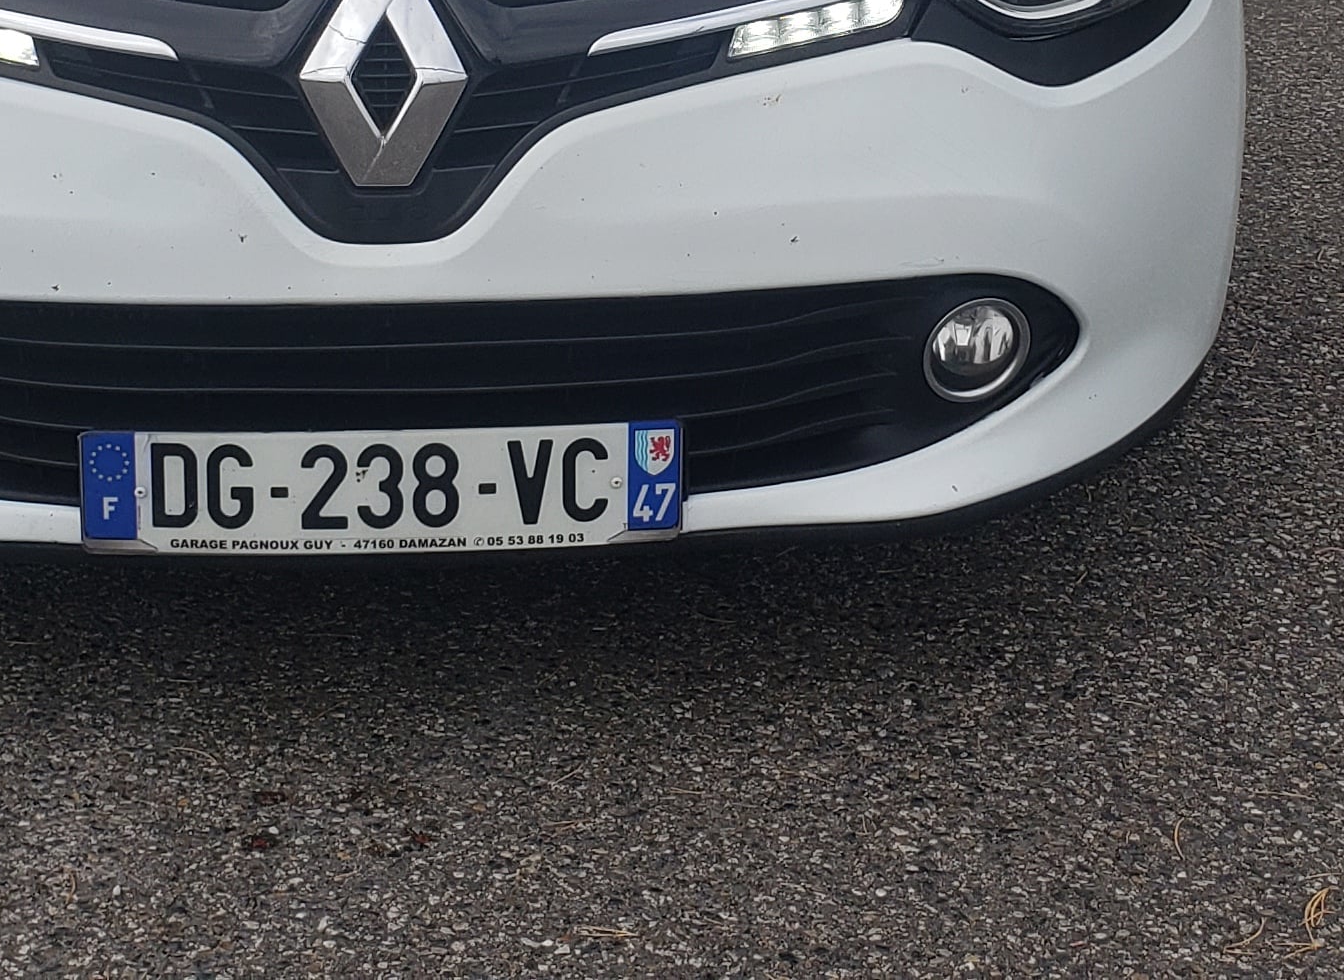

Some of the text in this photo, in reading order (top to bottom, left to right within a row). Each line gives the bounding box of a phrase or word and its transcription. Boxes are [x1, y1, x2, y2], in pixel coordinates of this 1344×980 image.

[150, 437, 609, 529] DG-238-VC
[103, 496, 119, 520] F
[632, 482, 676, 522] 47
[170, 538, 228, 550] GARAGE
[231, 539, 300, 550] PAGNOUX
[303, 539, 333, 550] GUY
[353, 538, 395, 550] 47160
[399, 537, 467, 549] DAMAZAN
[486, 536, 504, 547] 05
[507, 535, 524, 546] 53
[527, 534, 544, 545] 88
[548, 533, 564, 544] 19
[568, 532, 585, 543] 03
